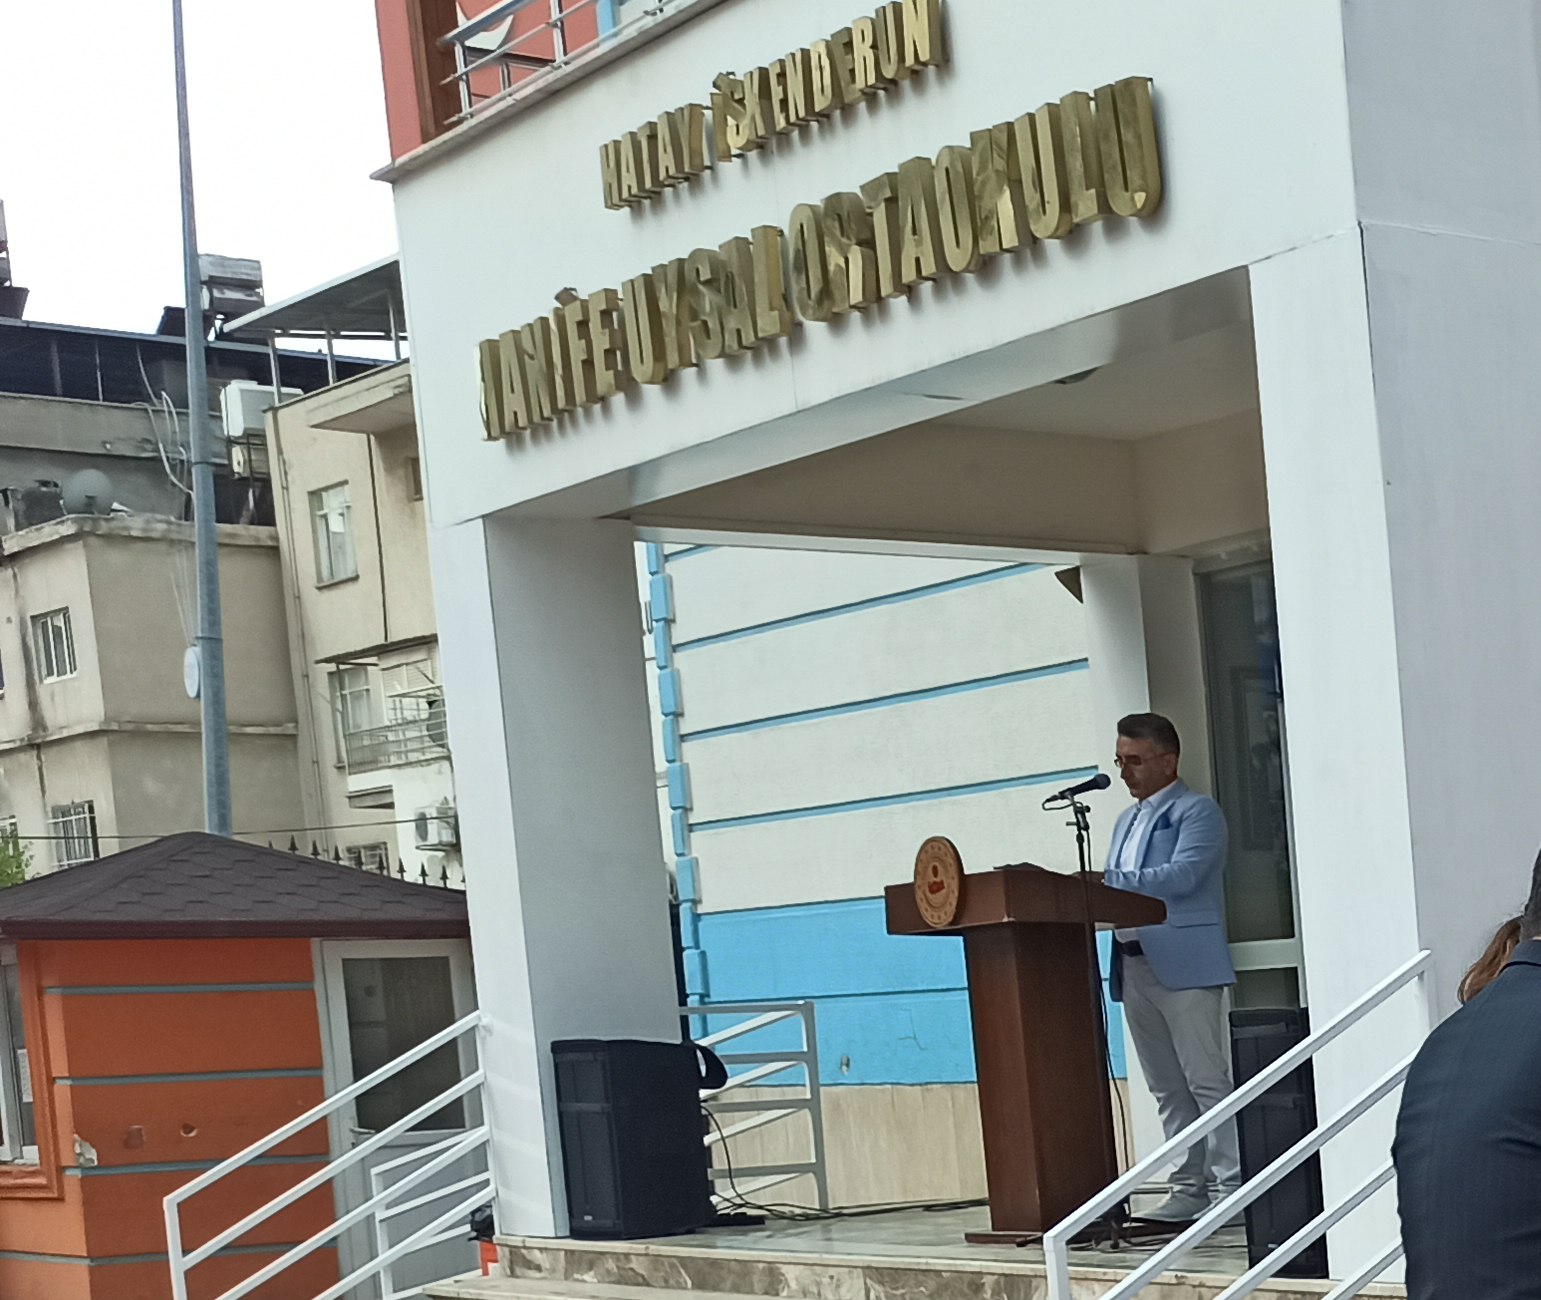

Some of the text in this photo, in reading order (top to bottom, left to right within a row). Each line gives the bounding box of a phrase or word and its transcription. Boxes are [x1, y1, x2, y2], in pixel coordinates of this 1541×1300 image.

[600, 103, 706, 210] HATAY
[622, 225, 793, 385] UYSAL
[788, 76, 1162, 322] ORTAOKULU
